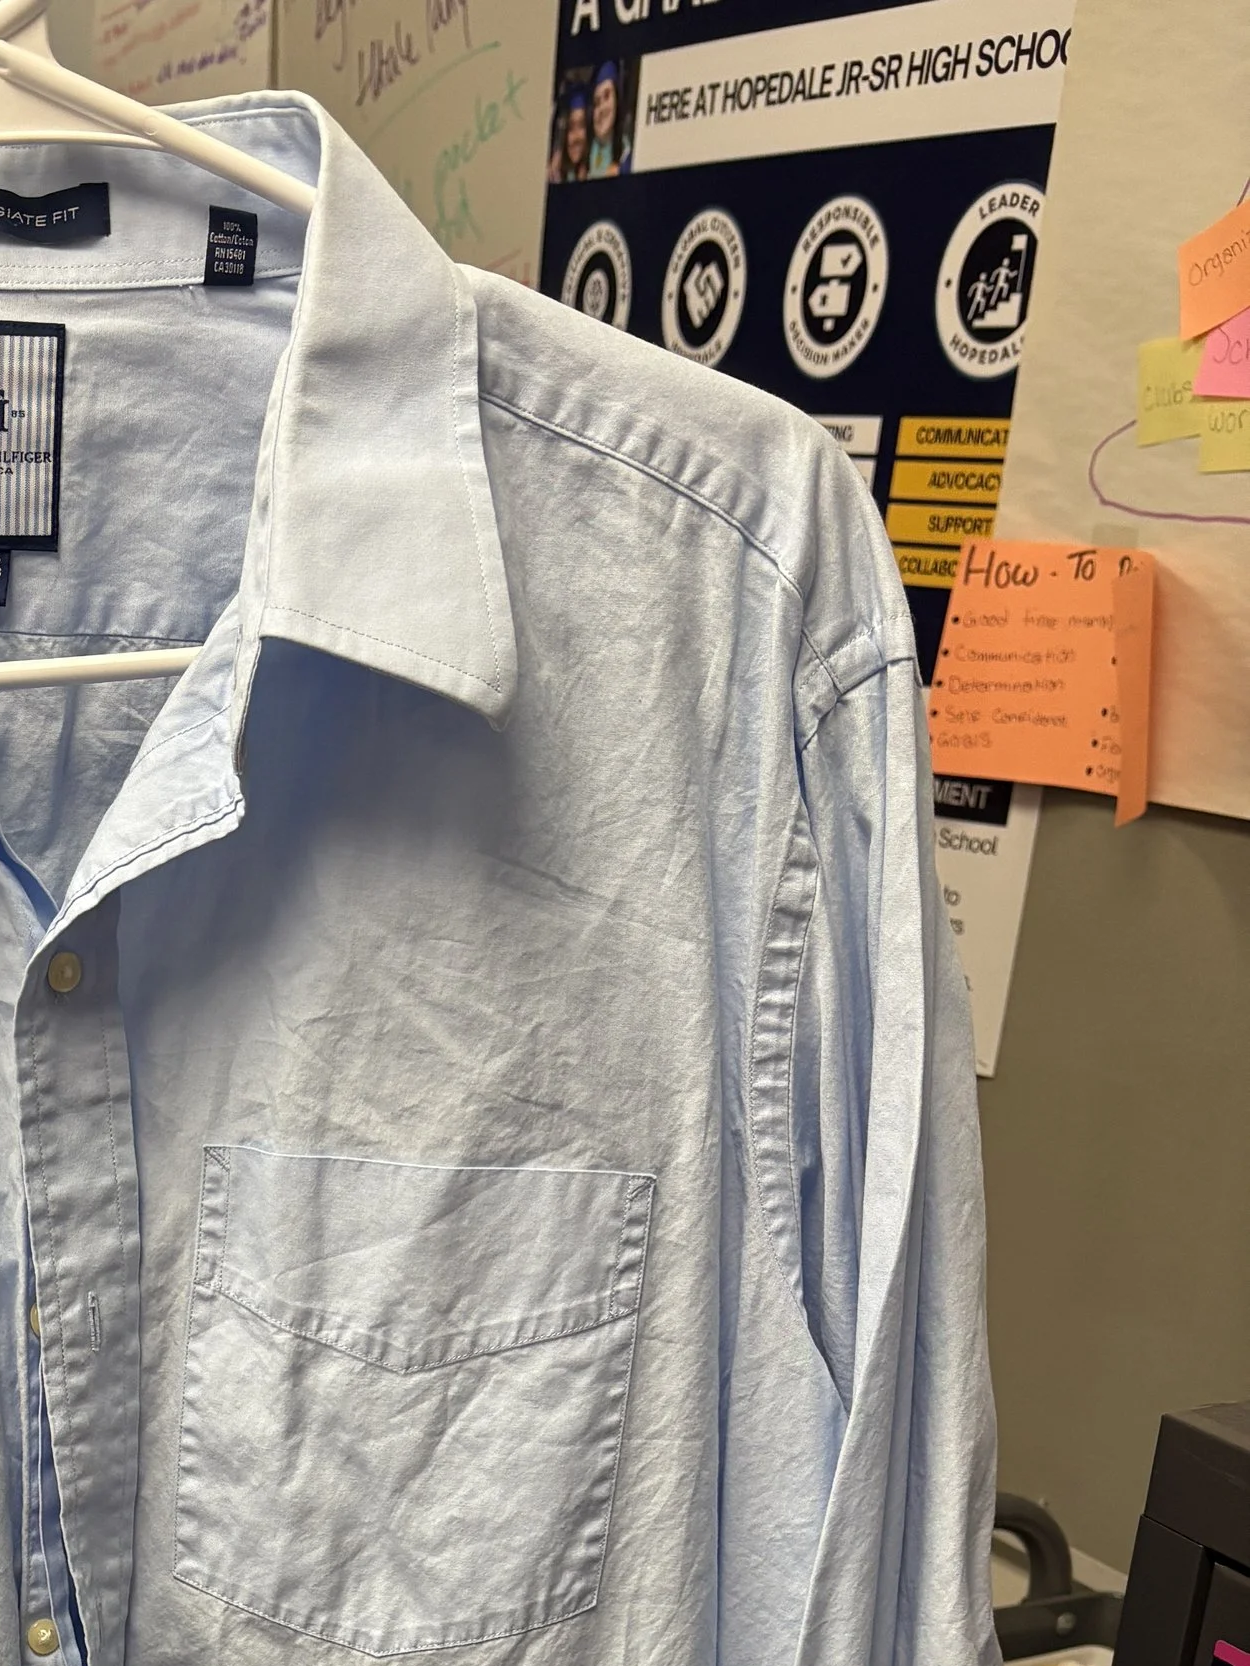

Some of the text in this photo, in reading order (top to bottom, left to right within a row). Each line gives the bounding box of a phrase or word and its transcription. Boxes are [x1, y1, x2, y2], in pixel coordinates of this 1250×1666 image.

[645, 86, 692, 125] HERE
[692, 82, 722, 118] AT
[722, 64, 836, 113] HOPEDALE
[835, 54, 903, 97] JR-SR
[906, 42, 973, 87] HIGH
[52, 206, 80, 225] FIT
[978, 192, 1041, 220] LEADER
[801, 205, 880, 252] RESPONSIBLE
[927, 516, 993, 535] SUPPORT
[962, 544, 1039, 589] How
[1066, 549, 1098, 580] To
[939, 827, 999, 857] School
